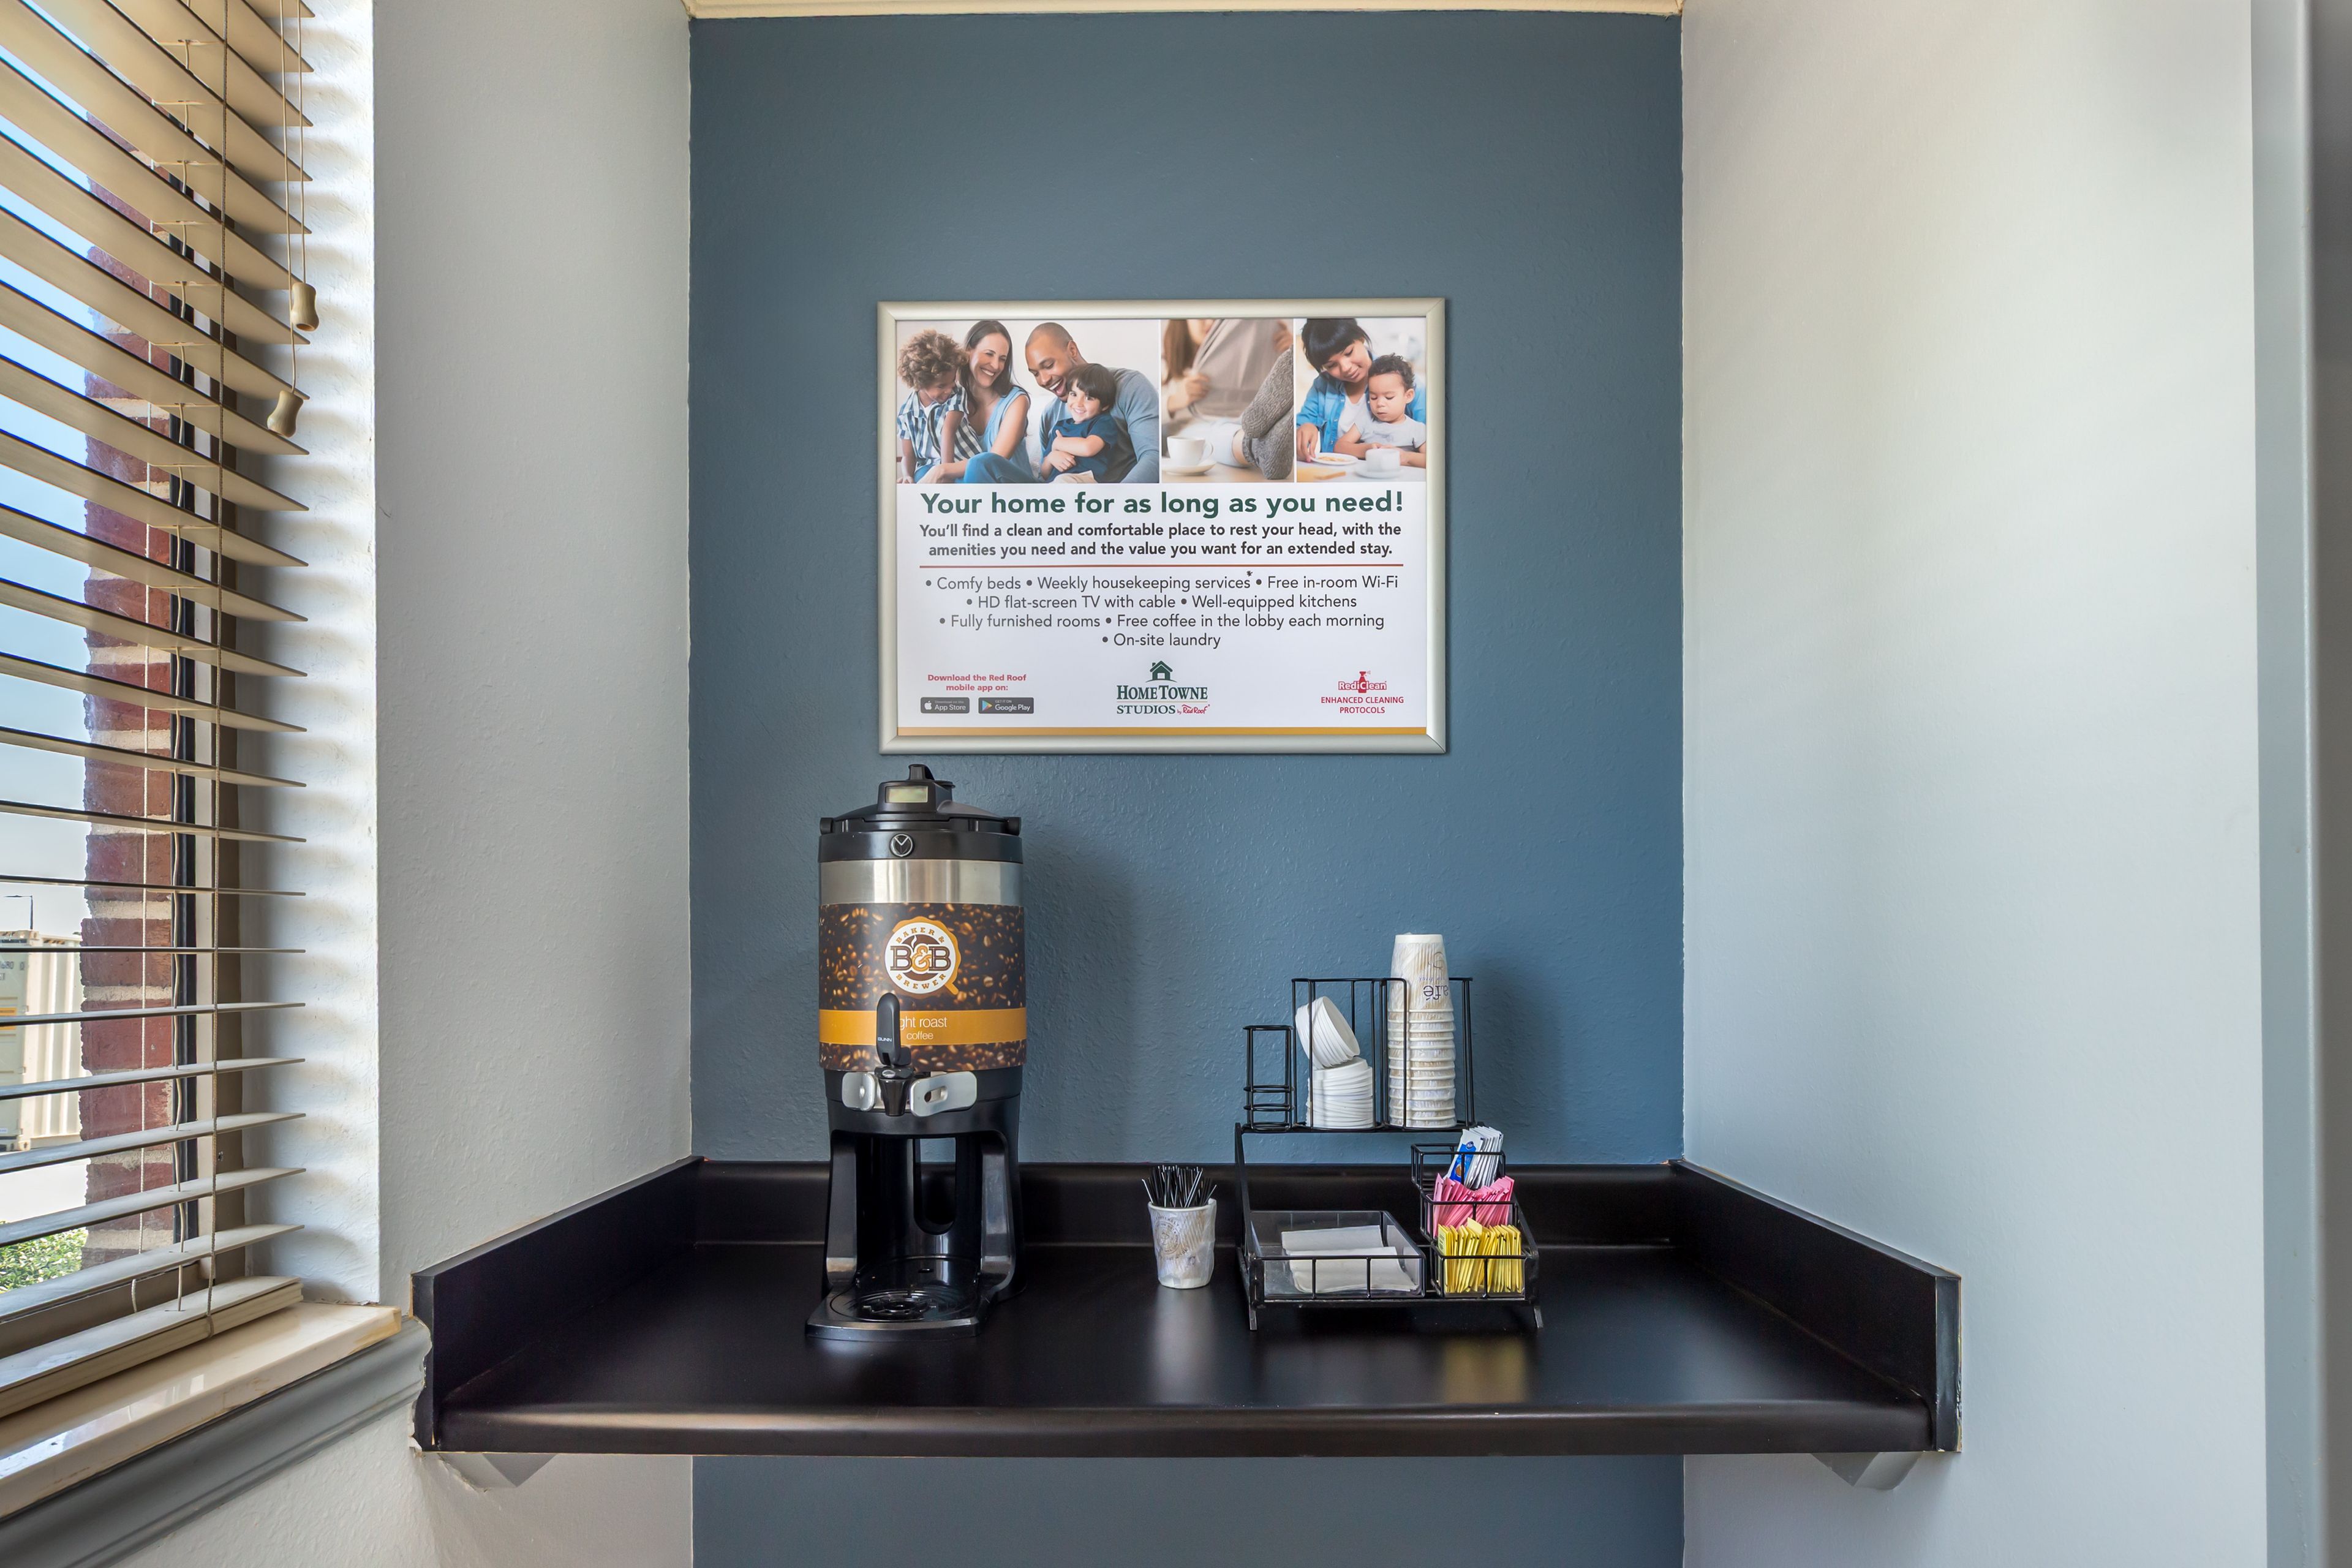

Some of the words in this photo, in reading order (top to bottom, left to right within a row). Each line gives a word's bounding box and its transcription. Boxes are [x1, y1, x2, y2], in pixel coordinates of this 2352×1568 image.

[921, 494, 982, 513] Your
[992, 492, 1065, 513] home
[1075, 492, 1114, 513] for
[1124, 499, 1151, 513] as
[1162, 492, 1218, 518] long
[1229, 499, 1257, 512] as
[1266, 498, 1314, 518] you
[1326, 490, 1402, 511] need!
[919, 524, 957, 537] You’ll
[962, 524, 989, 536] find
[995, 527, 1001, 536] a
[1007, 523, 1042, 536] clean
[1047, 523, 1072, 536] and
[1078, 523, 1163, 535] comfortable
[1169, 522, 1205, 539] place
[1210, 525, 1225, 535] to
[1231, 524, 1257, 535] rest
[1262, 527, 1294, 538] your
[1299, 522, 1336, 537] head,
[1343, 522, 1373, 535] with
[1378, 522, 1401, 535] the
[929, 543, 996, 556] amenities
[1001, 547, 1026, 559] you
[1031, 542, 1065, 555] need
[1071, 542, 1095, 554] and
[1101, 542, 1123, 554] the
[1129, 541, 1166, 554] value
[1171, 546, 1196, 558] you
[1201, 543, 1236, 554] want
[1241, 541, 1262, 554] for
[1288, 541, 1354, 554] extended
[1360, 543, 1392, 557] stay.
[937, 576, 982, 592] Comfy
[988, 576, 1020, 589] beds
[1038, 576, 1088, 592] Weekly
[1093, 576, 1189, 593] housekeeping
[1268, 576, 1298, 588] Free
[1304, 576, 1357, 588] in-room
[1362, 576, 1397, 587] Wi-Fi
[979, 596, 1000, 608] HD
[1005, 595, 1076, 608] flat-screen
[1082, 595, 1100, 608] TV
[1104, 595, 1133, 608] with
[1139, 595, 1175, 608] cable
[1192, 594, 1294, 612] Well-equipped
[1300, 594, 1356, 607] kitchens
[952, 614, 982, 630] Fully
[987, 614, 1052, 627] furnished
[1118, 614, 1148, 627] Free
[1153, 614, 1196, 627] coffee
[1202, 614, 1212, 627] in
[1218, 614, 1240, 627] the
[1246, 614, 1284, 630] lobby
[1289, 614, 1321, 626] each
[1327, 614, 1384, 630] morning
[1114, 633, 1164, 646] On-site
[1170, 633, 1220, 649] laundry
[1338, 680, 1387, 691] RediClean
[896, 927, 935, 943] BAKER
[890, 945, 951, 971] B&B
[896, 973, 946, 989] BREWER
[1423, 985, 1449, 1001] afé
[900, 1016, 916, 1030] ght
[919, 1017, 948, 1028] roast
[907, 1030, 934, 1040] coffee
